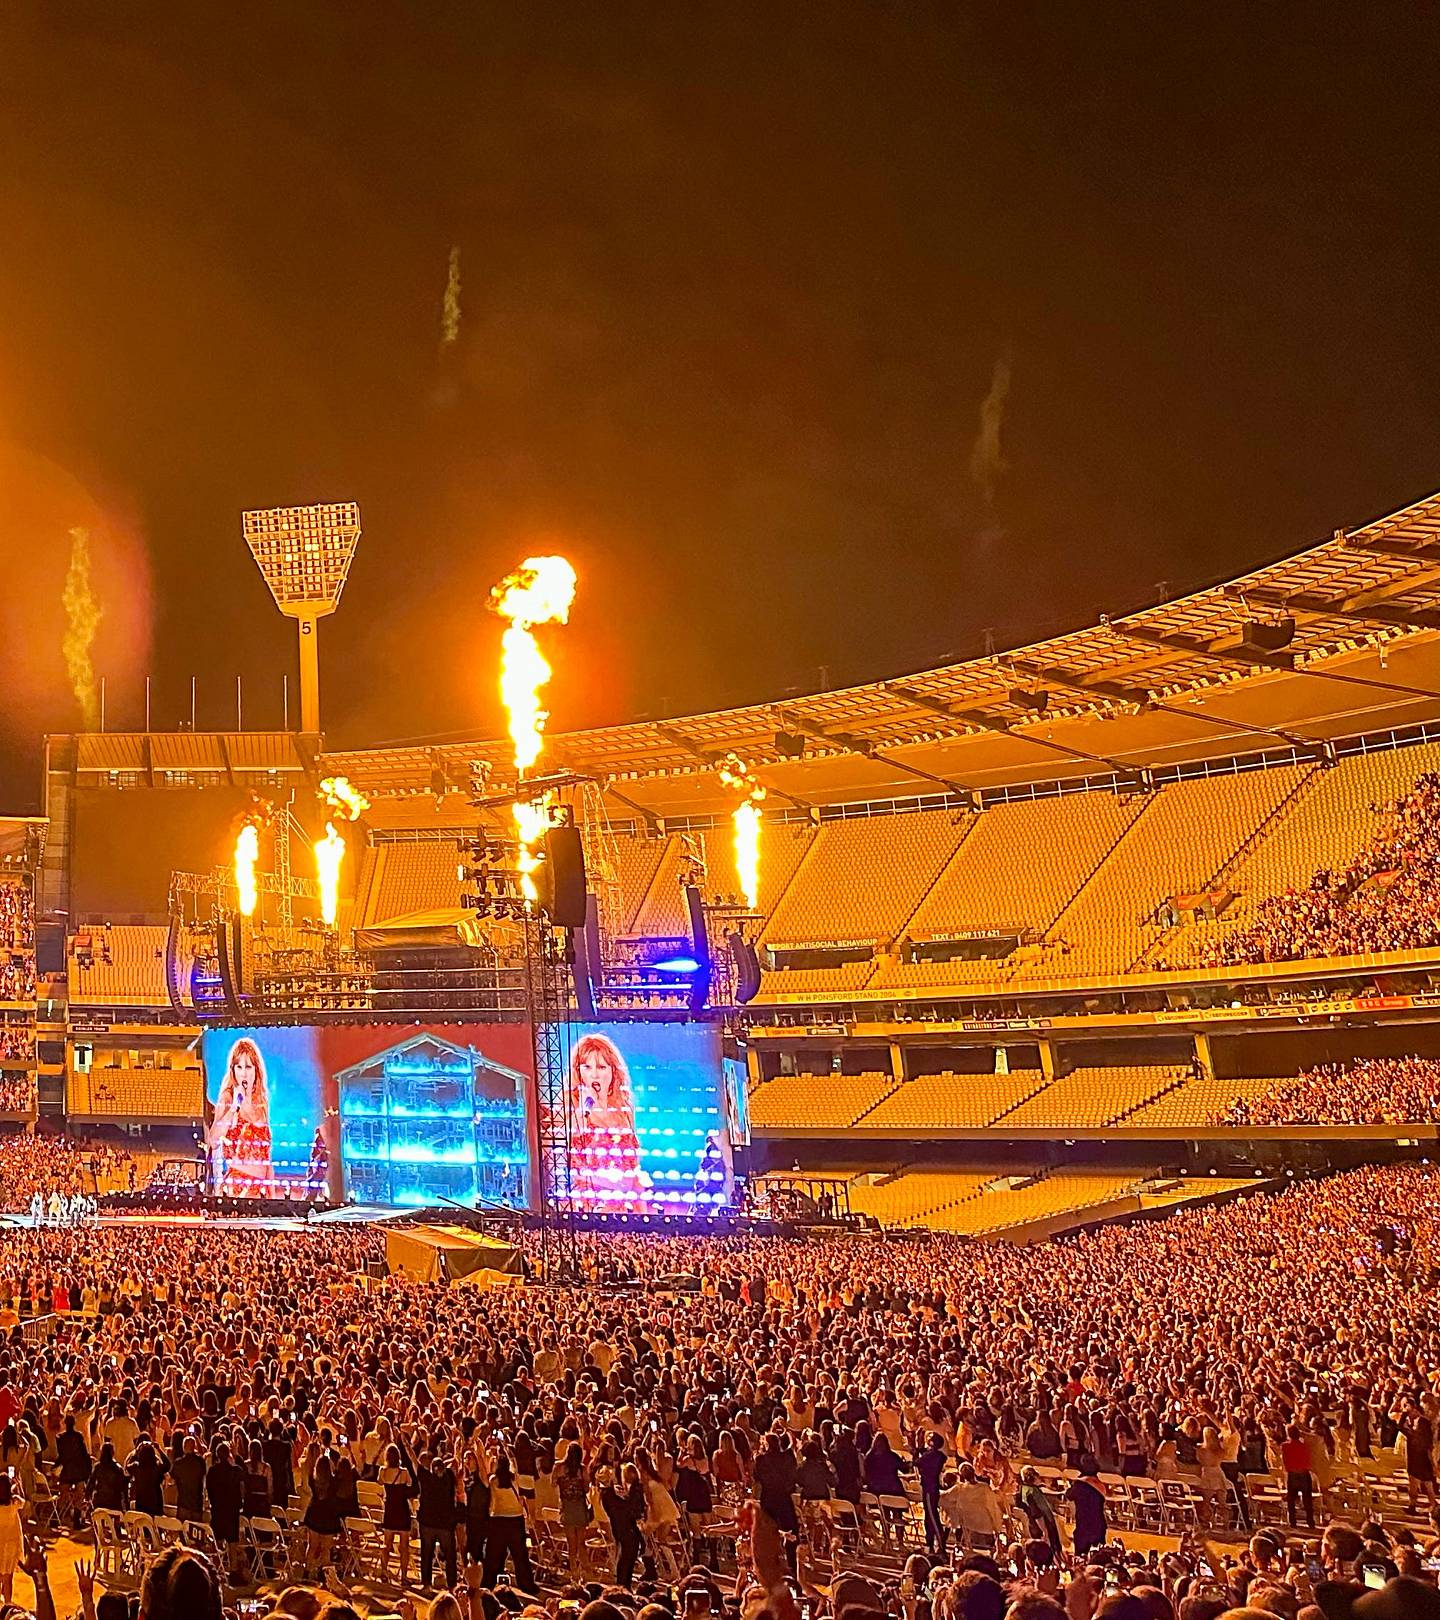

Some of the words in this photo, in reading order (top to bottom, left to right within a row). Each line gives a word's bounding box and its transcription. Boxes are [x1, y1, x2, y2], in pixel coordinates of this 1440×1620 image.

[302, 621, 311, 635] 5
[931, 933, 949, 941] TEXT
[795, 940, 836, 950] ANTISOCIAL
[813, 991, 853, 1001] PONSFORD
[855, 990, 879, 1000] STAND
[1167, 1485, 1181, 1496] C3
